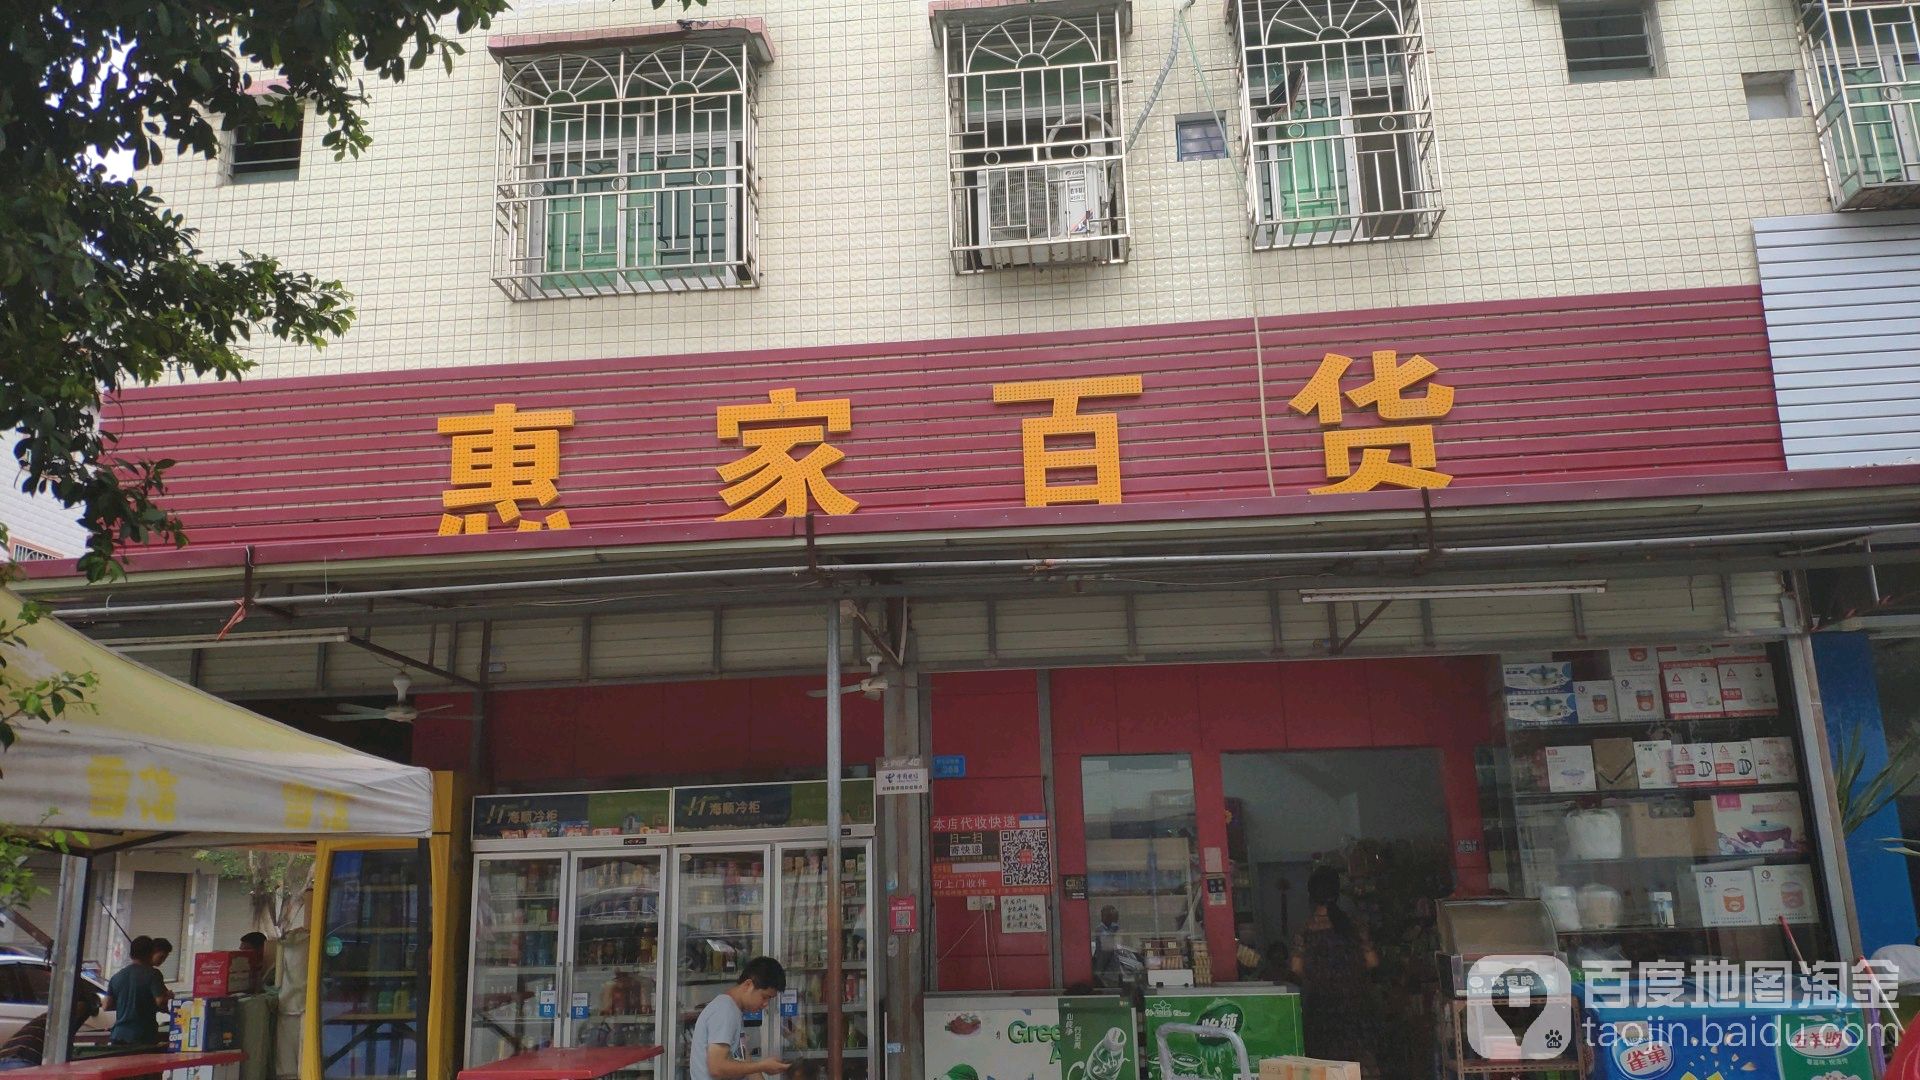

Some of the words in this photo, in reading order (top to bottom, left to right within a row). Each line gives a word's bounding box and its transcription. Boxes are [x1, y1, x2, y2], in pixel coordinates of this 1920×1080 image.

[437, 350, 1455, 537] 惠家百货
[709, 800, 761, 816] 海顺冷柜
[507, 809, 558, 824] 海顺冷柜
[933, 815, 1016, 831] 本店代收快递
[933, 879, 988, 889] 可上门收件
[1626, 1045, 1668, 1071] 雀巢
